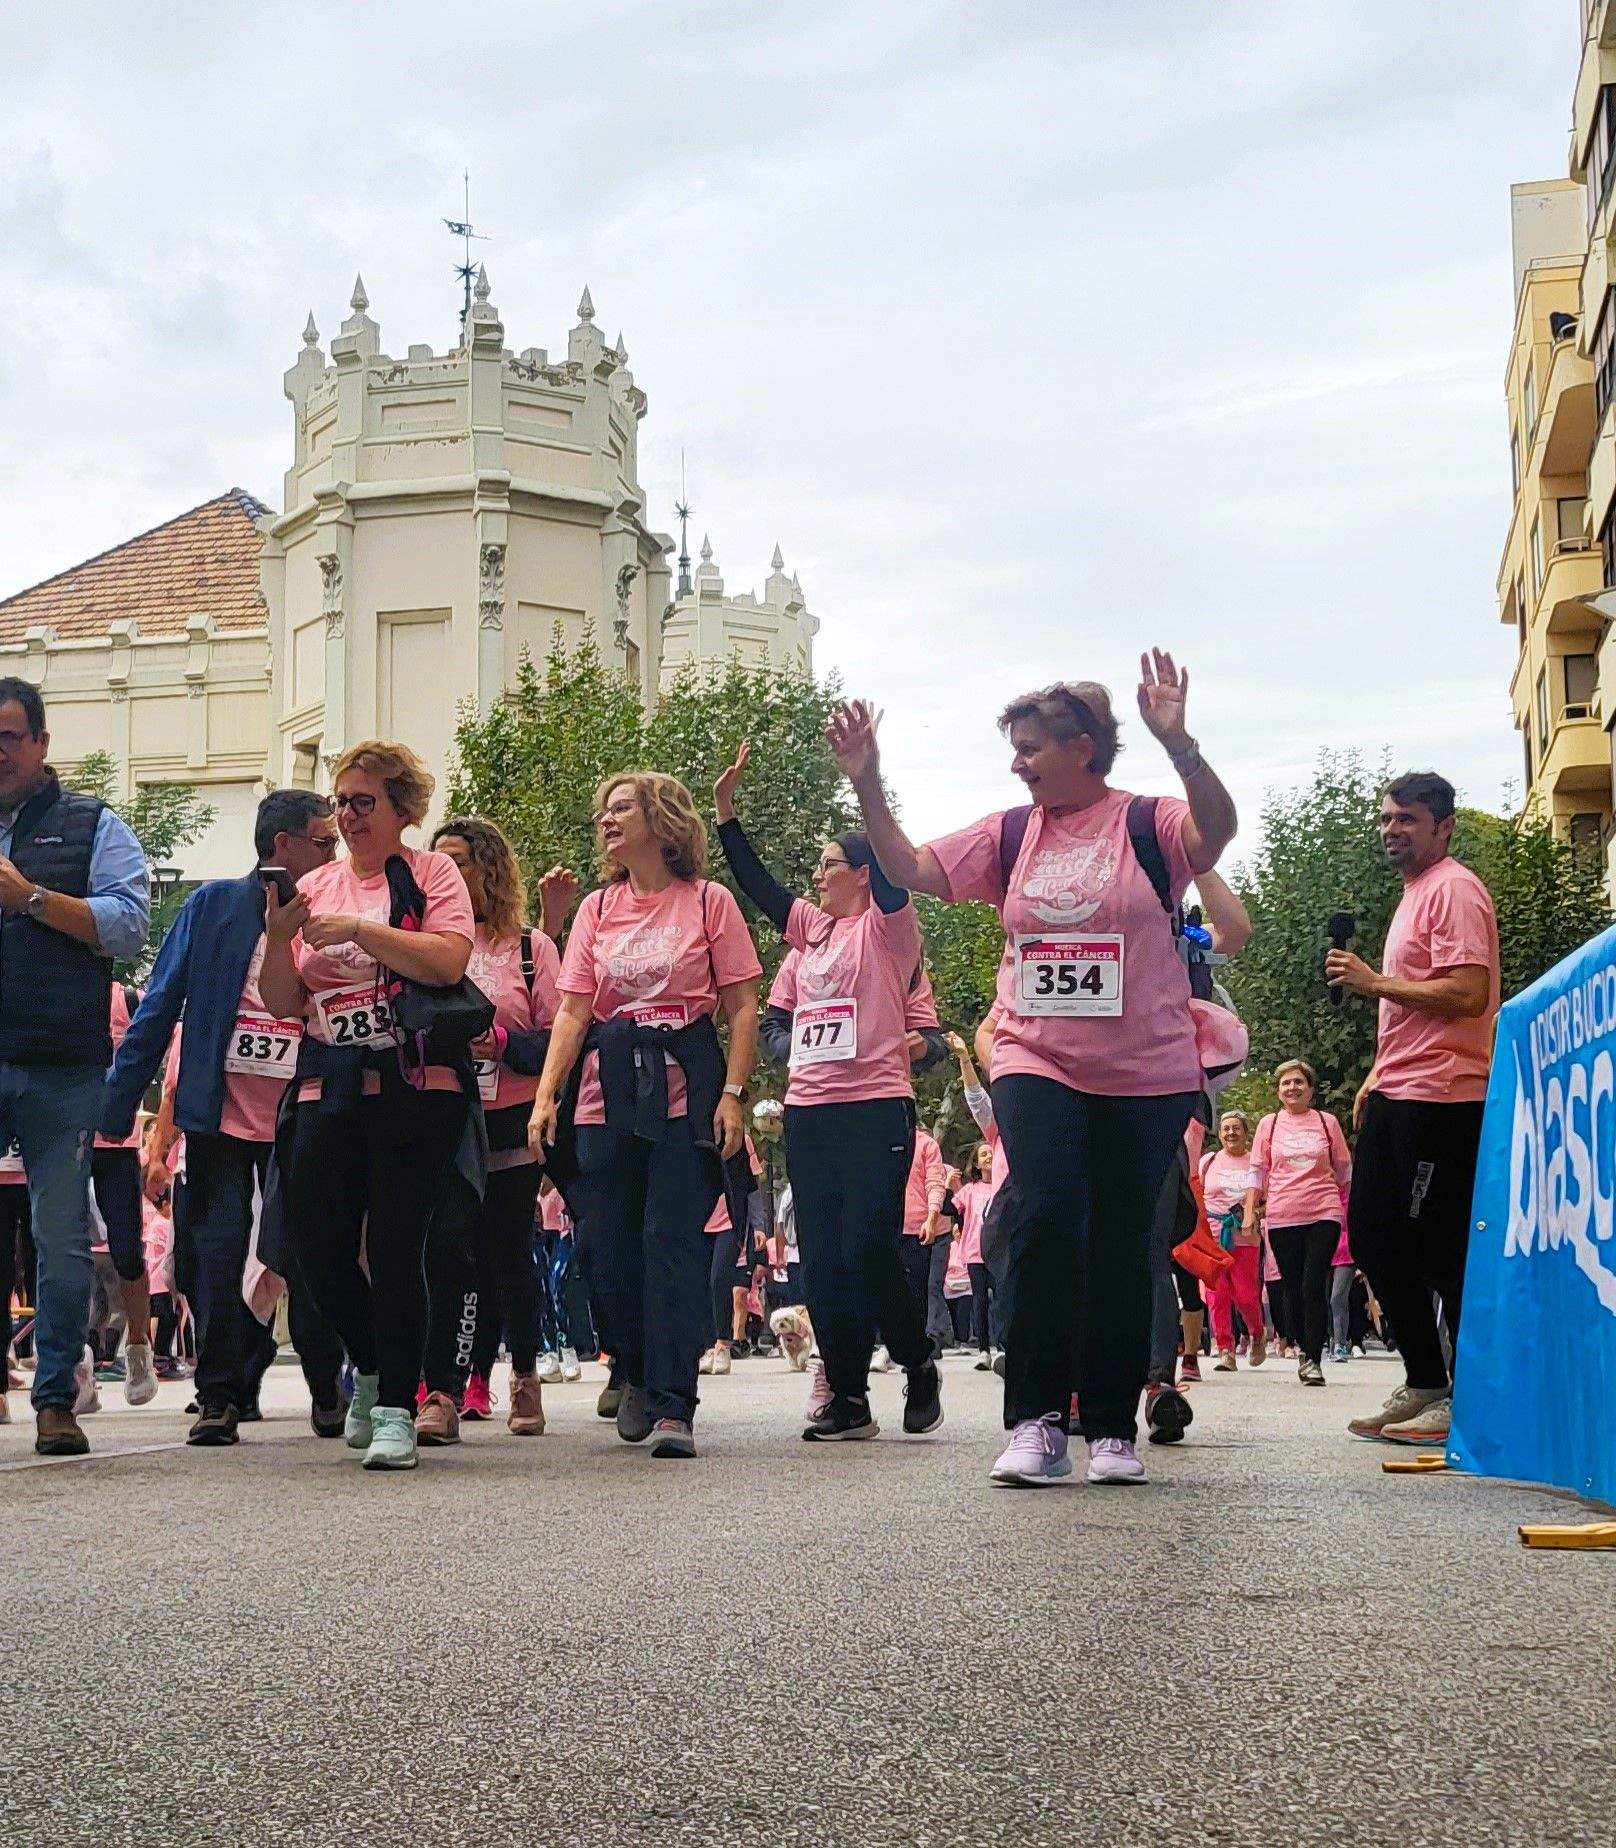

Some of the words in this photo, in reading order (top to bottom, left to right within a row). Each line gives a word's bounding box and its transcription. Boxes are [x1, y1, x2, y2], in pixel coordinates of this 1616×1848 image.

[1026, 951, 1061, 960] CONTRA
[1064, 951, 1075, 960] EL
[1035, 964, 1104, 995] 354
[328, 999, 363, 1013] CONTRA
[236, 1022, 261, 1032] ONTRA
[330, 1005, 392, 1043] 283
[801, 1021, 843, 1048] 477
[236, 1033, 292, 1061] 837
[455, 1291, 478, 1367] adidas
